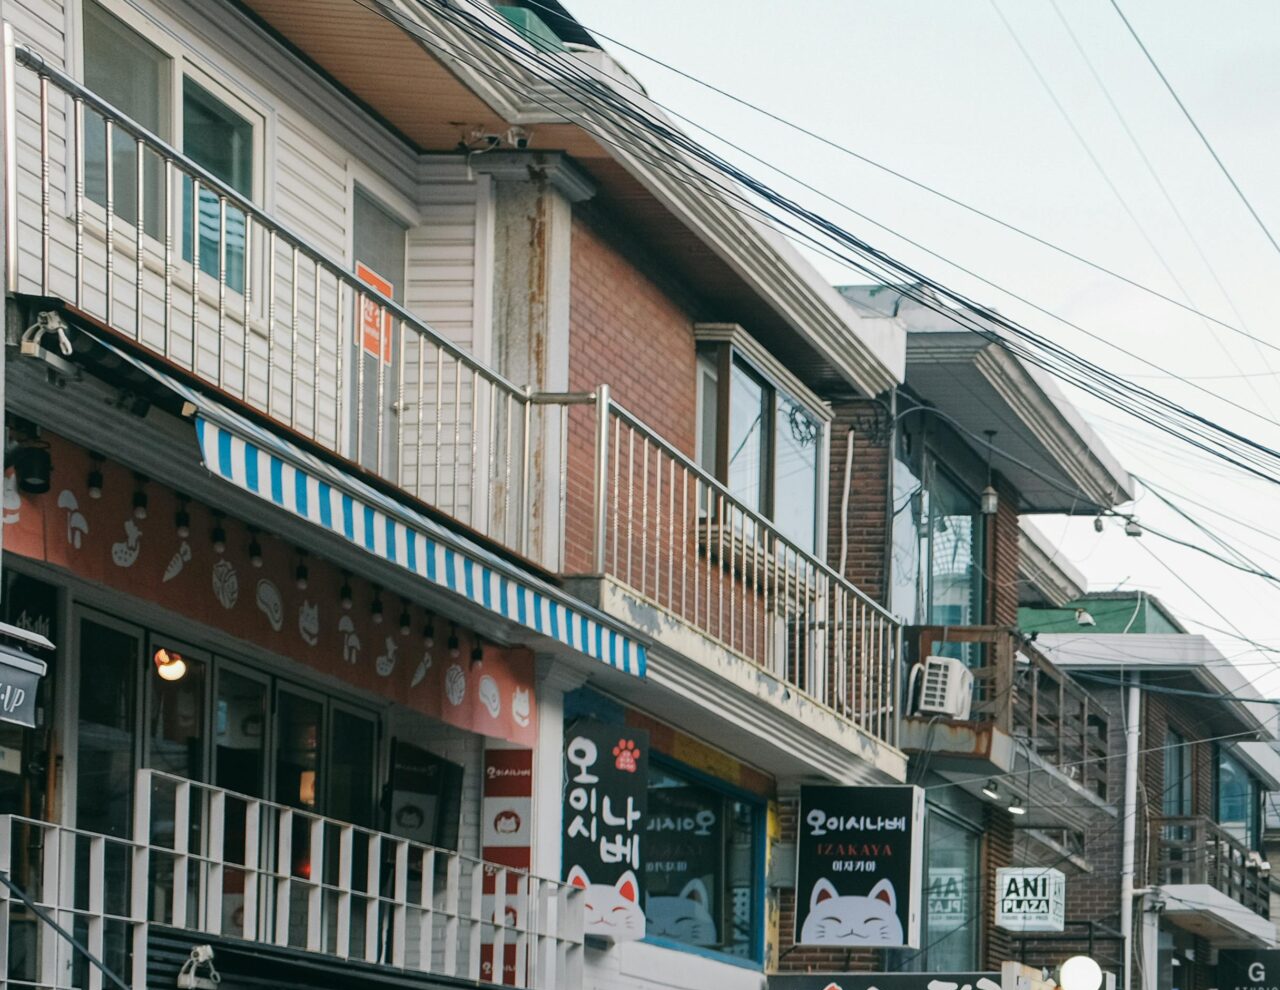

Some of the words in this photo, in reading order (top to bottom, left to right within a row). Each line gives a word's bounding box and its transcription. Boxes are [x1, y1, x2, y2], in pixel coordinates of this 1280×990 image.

[567, 736, 599, 842] 오이시
[600, 795, 641, 870] 나베
[806, 809, 906, 836] 오이시나베
[816, 844, 893, 856] IZAKAYA
[1005, 878, 1047, 898] ANI
[1003, 900, 1049, 913] PLAZA
[1248, 963, 1265, 981] G
